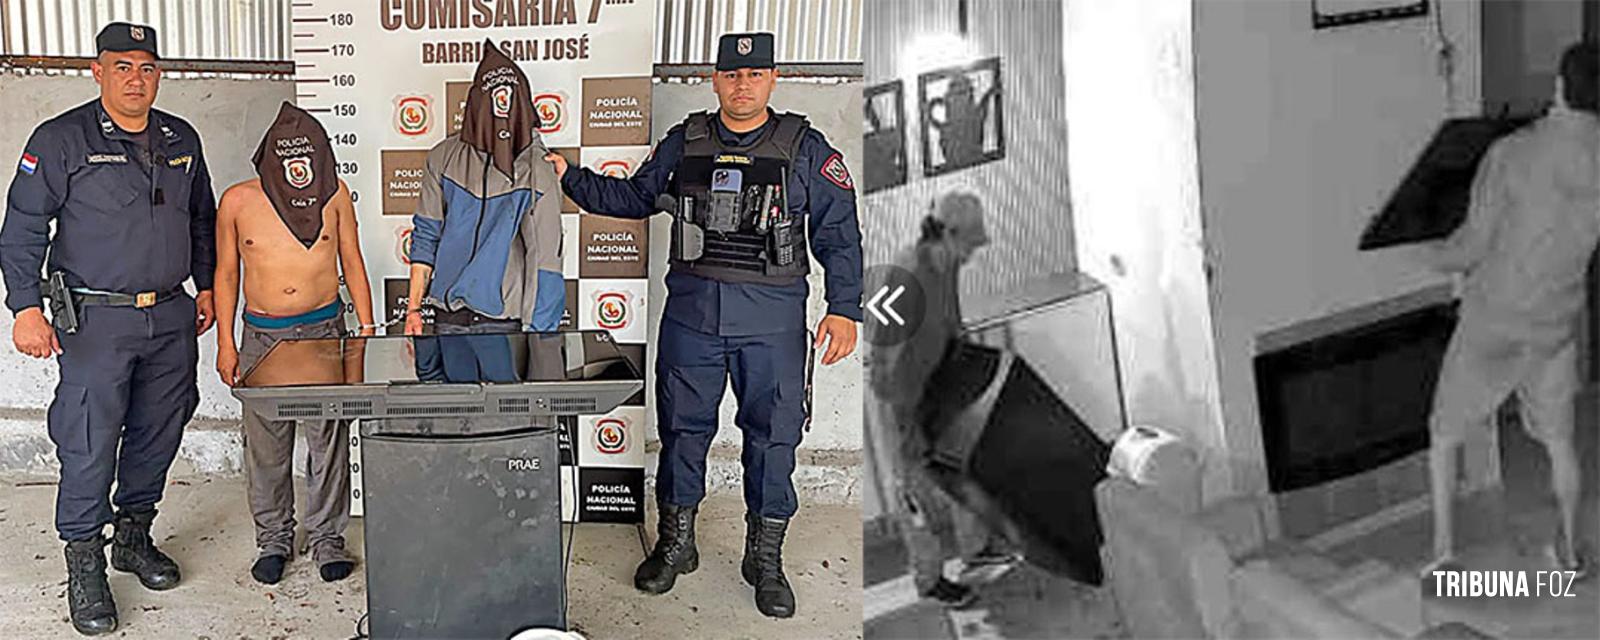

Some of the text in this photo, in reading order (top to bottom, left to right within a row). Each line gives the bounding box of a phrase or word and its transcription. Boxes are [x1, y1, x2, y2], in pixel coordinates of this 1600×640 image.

[330, 13, 353, 26] 180
[331, 43, 354, 56] 170
[422, 33, 589, 63] BARRI SAN JOSÉ
[332, 74, 355, 87] 160
[596, 96, 637, 107] POLICÍA
[333, 104, 356, 117] 150
[590, 110, 643, 119] NACIONAL
[334, 133, 357, 146] 140
[336, 162, 358, 174] 130
[395, 169, 423, 177] POLIC
[390, 181, 423, 189] NACIO
[593, 232, 634, 241] POLICÍA
[587, 245, 639, 253] NACIONAL
[508, 458, 540, 470] PRAE
[592, 484, 631, 494] POLICÍA
[586, 495, 637, 505] NACIONAL
